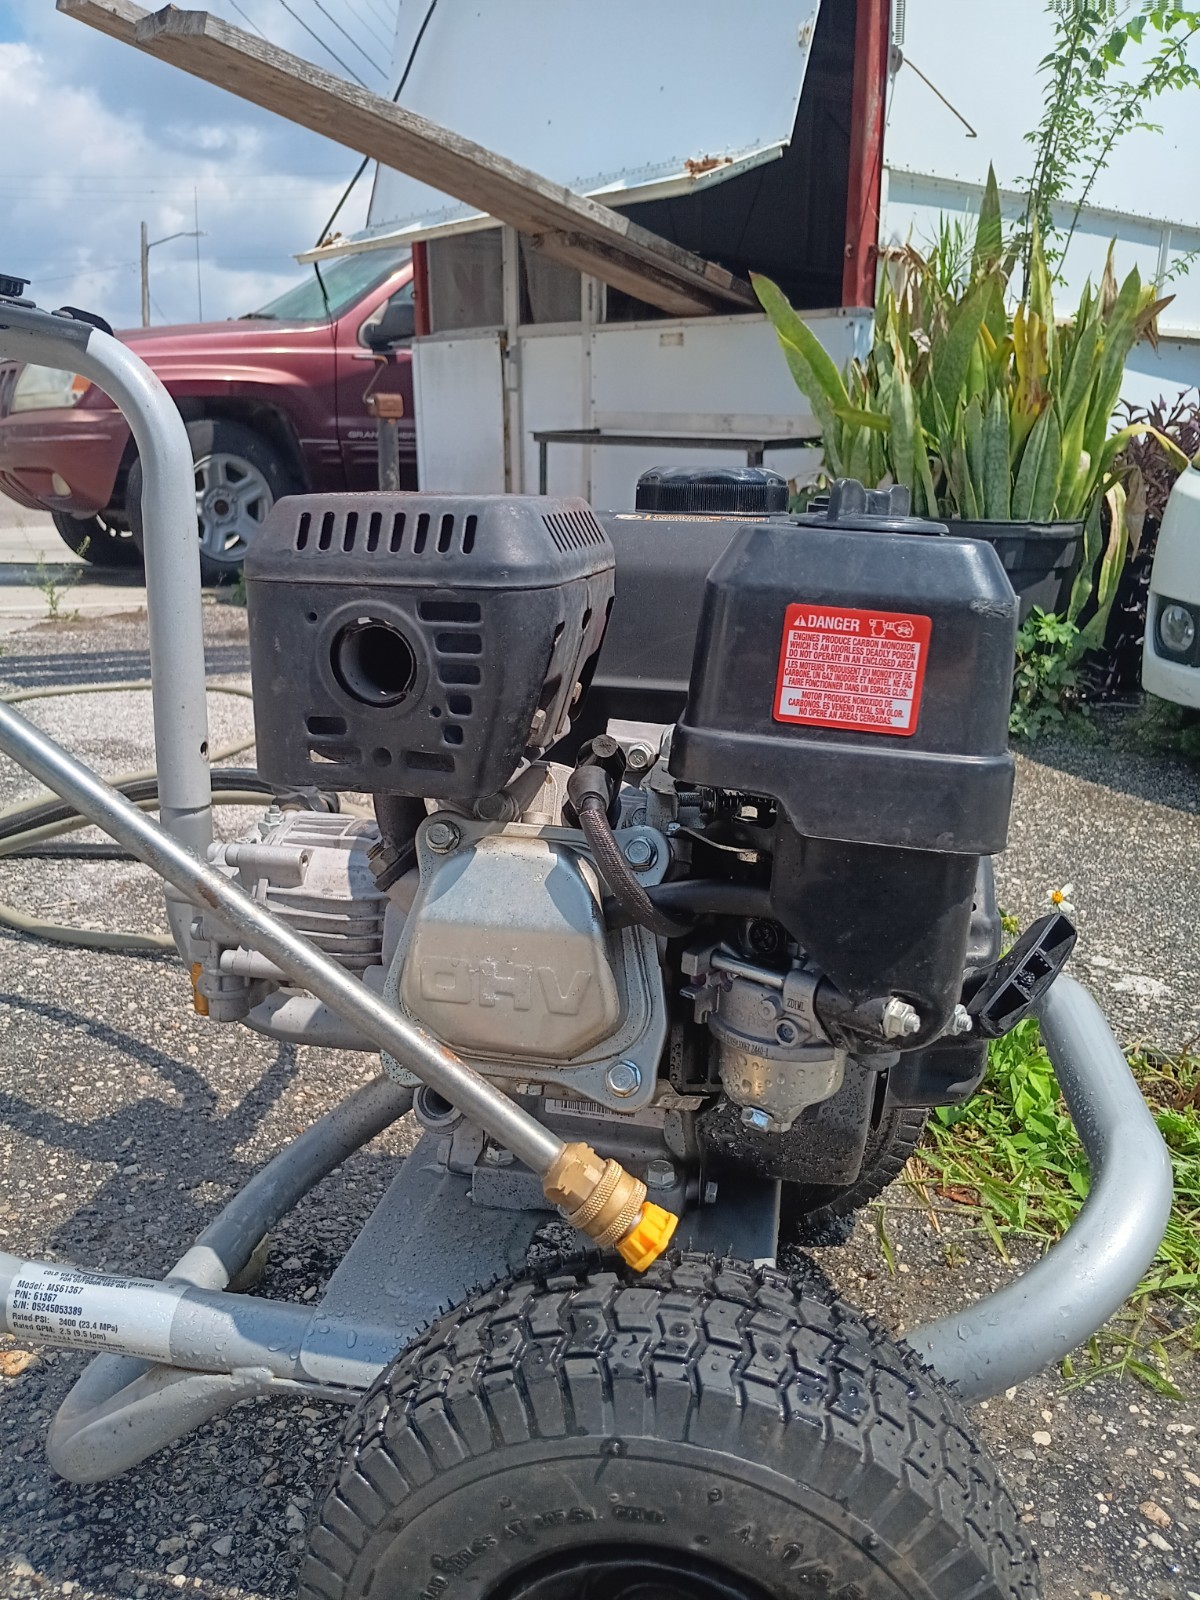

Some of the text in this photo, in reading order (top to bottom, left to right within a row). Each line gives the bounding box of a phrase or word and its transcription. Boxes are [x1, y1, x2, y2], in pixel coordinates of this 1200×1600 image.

[807, 614, 860, 632] DANGER
[790, 640, 916, 661] WHICH IS AN ODORLESS DEADLY POISON
[793, 632, 915, 652] ENGINES PRODUCE CARBON MONOXIDE
[789, 649, 915, 669] DO NOT OPERATE IN AN ENCLOSED AREA
[788, 660, 798, 668] LES
[799, 661, 826, 671] MOTEURS
[826, 664, 861, 677] PRODUISENT
[862, 667, 870, 676] DU
[904, 672, 912, 680] DE
[788, 677, 908, 697] FAIRE FONCTIONNER DANS UN ESPACE CLOS.
[813, 671, 821, 679] UN
[822, 672, 833, 680] GAZ
[834, 673, 858, 683] INODORE
[901, 680, 913, 689] PAS
[802, 691, 822, 700] MOTOR
[823, 693, 851, 704] PRODUCE
[884, 699, 893, 708] DE
[799, 707, 807, 715] NO
[809, 709, 827, 718] OPERE
[838, 711, 858, 721] AREAS
[859, 714, 892, 725] CERRADAS.
[823, 702, 830, 710] ES
[832, 702, 854, 712] VENENO
[856, 705, 873, 714] FATAL
[875, 707, 885, 716] SIN
[886, 708, 904, 718] OLOR.
[420, 956, 592, 1016] OHV
[15, 1290, 58, 1302] P/N: 61367
[17, 1280, 84, 1294] Model: MS61367
[13, 1300, 82, 1316] S/N: 05245053389
[12, 1312, 33, 1321] Rated
[35, 1314, 50, 1323] PSI:
[79, 1320, 97, 1329] (23.4
[99, 1322, 118, 1334] MPa)
[13, 1322, 34, 1330] Rated
[36, 1324, 55, 1333] GPM:
[74, 1329, 87, 1337] (9.5
[90, 1331, 106, 1341] lpm)
